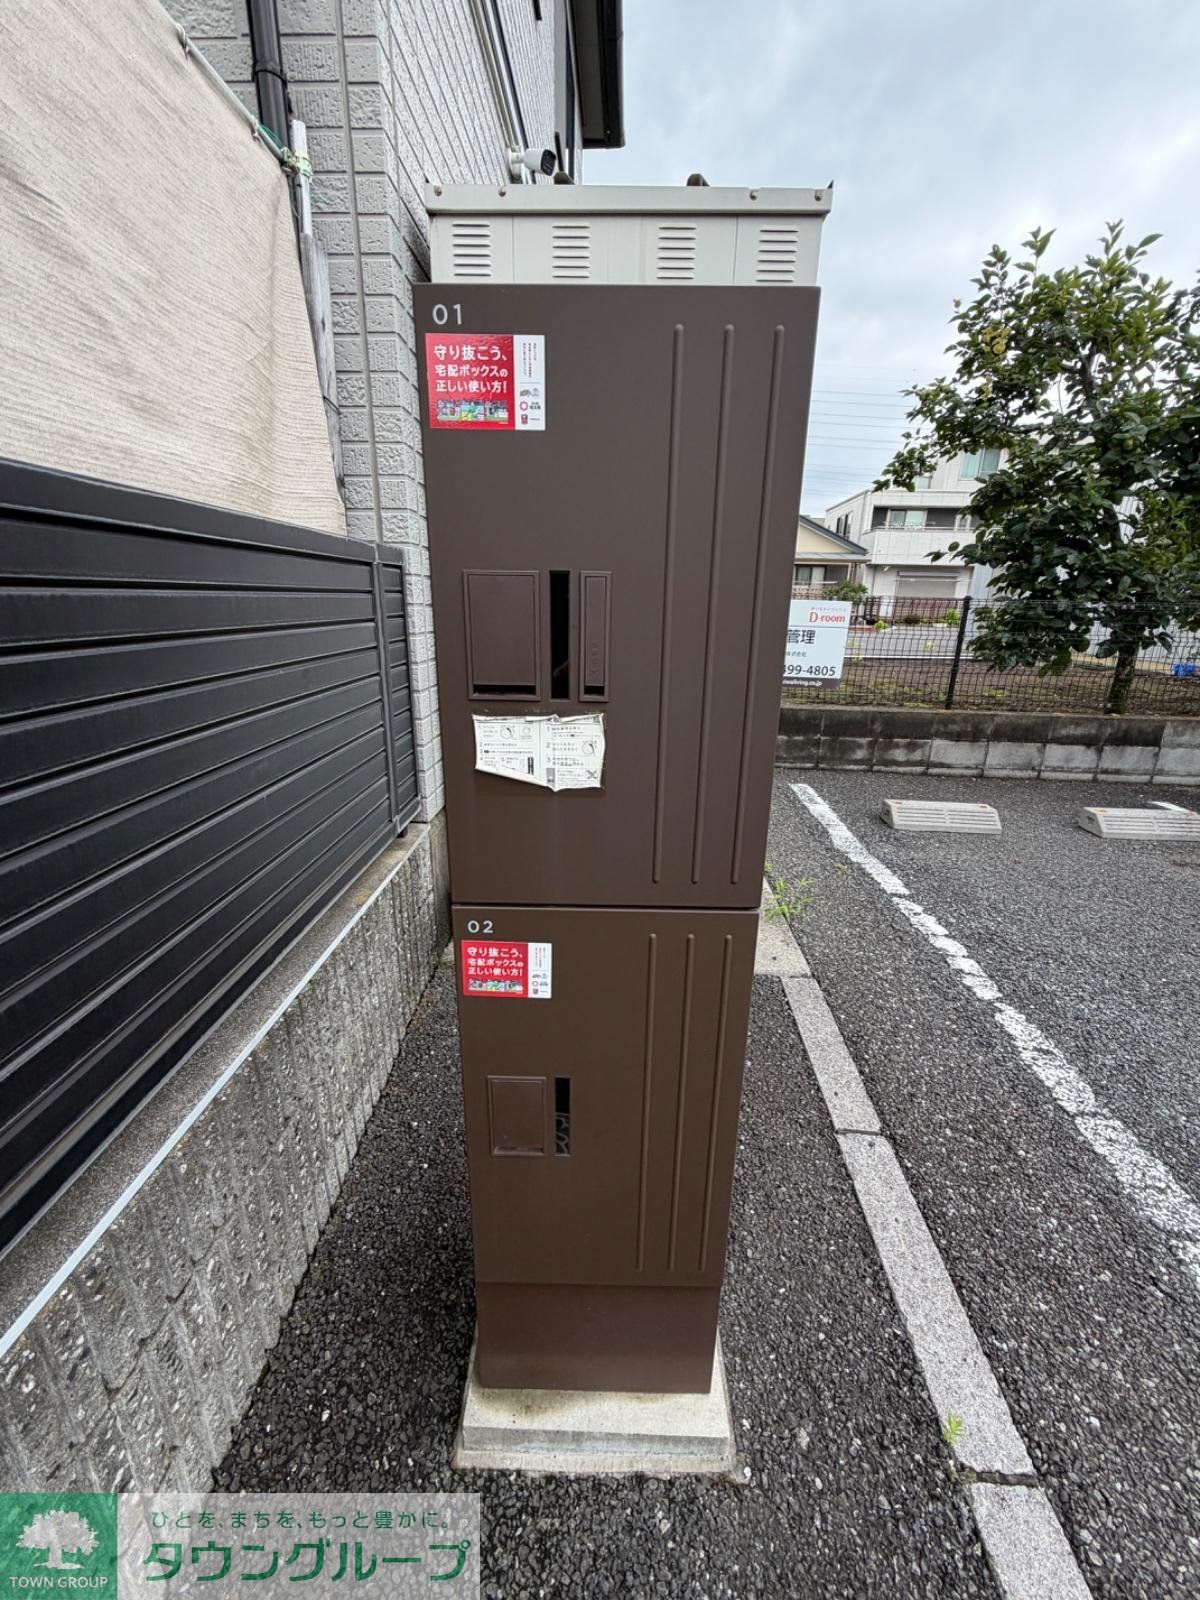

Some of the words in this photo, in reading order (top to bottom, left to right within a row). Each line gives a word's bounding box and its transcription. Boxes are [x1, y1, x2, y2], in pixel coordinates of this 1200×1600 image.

[432, 303, 463, 325] 01
[433, 344, 508, 361] 守り抜こう、
[434, 364, 508, 377] 宅配ボックスの
[808, 611, 846, 623] D-room
[787, 629, 816, 645] 管理
[467, 920, 494, 934] 02
[467, 947, 524, 958] 守り抜こう、
[467, 958, 524, 968] 宅配ボックスの
